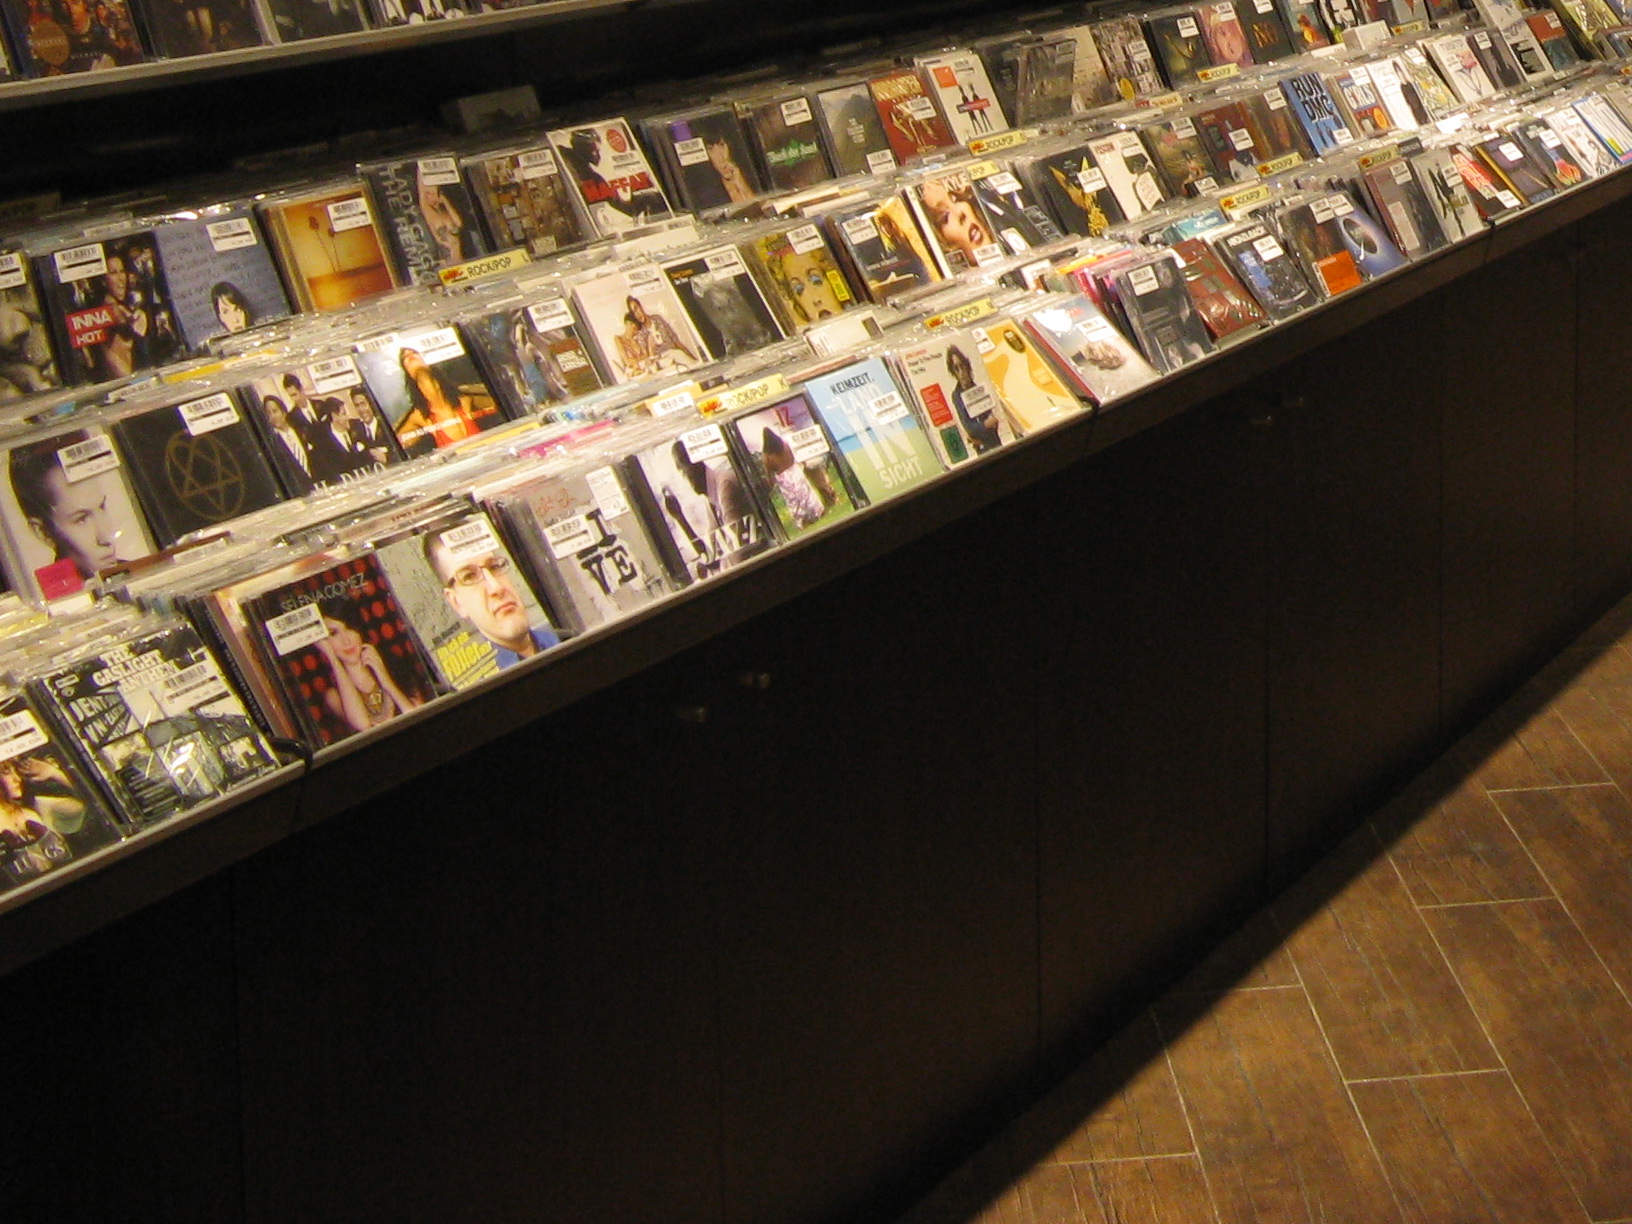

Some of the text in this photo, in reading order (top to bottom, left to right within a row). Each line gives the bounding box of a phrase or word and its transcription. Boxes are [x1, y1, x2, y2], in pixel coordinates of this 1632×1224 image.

[1291, 72, 1326, 101] RUN
[1301, 95, 1335, 123] DMC
[467, 257, 512, 278] ROCK/POP
[71, 309, 113, 331] INNA
[76, 329, 103, 346] HOT
[879, 457, 924, 490] SICHT
[323, 572, 365, 599] GOMEZ
[92, 649, 165, 688] GASLIGHT
